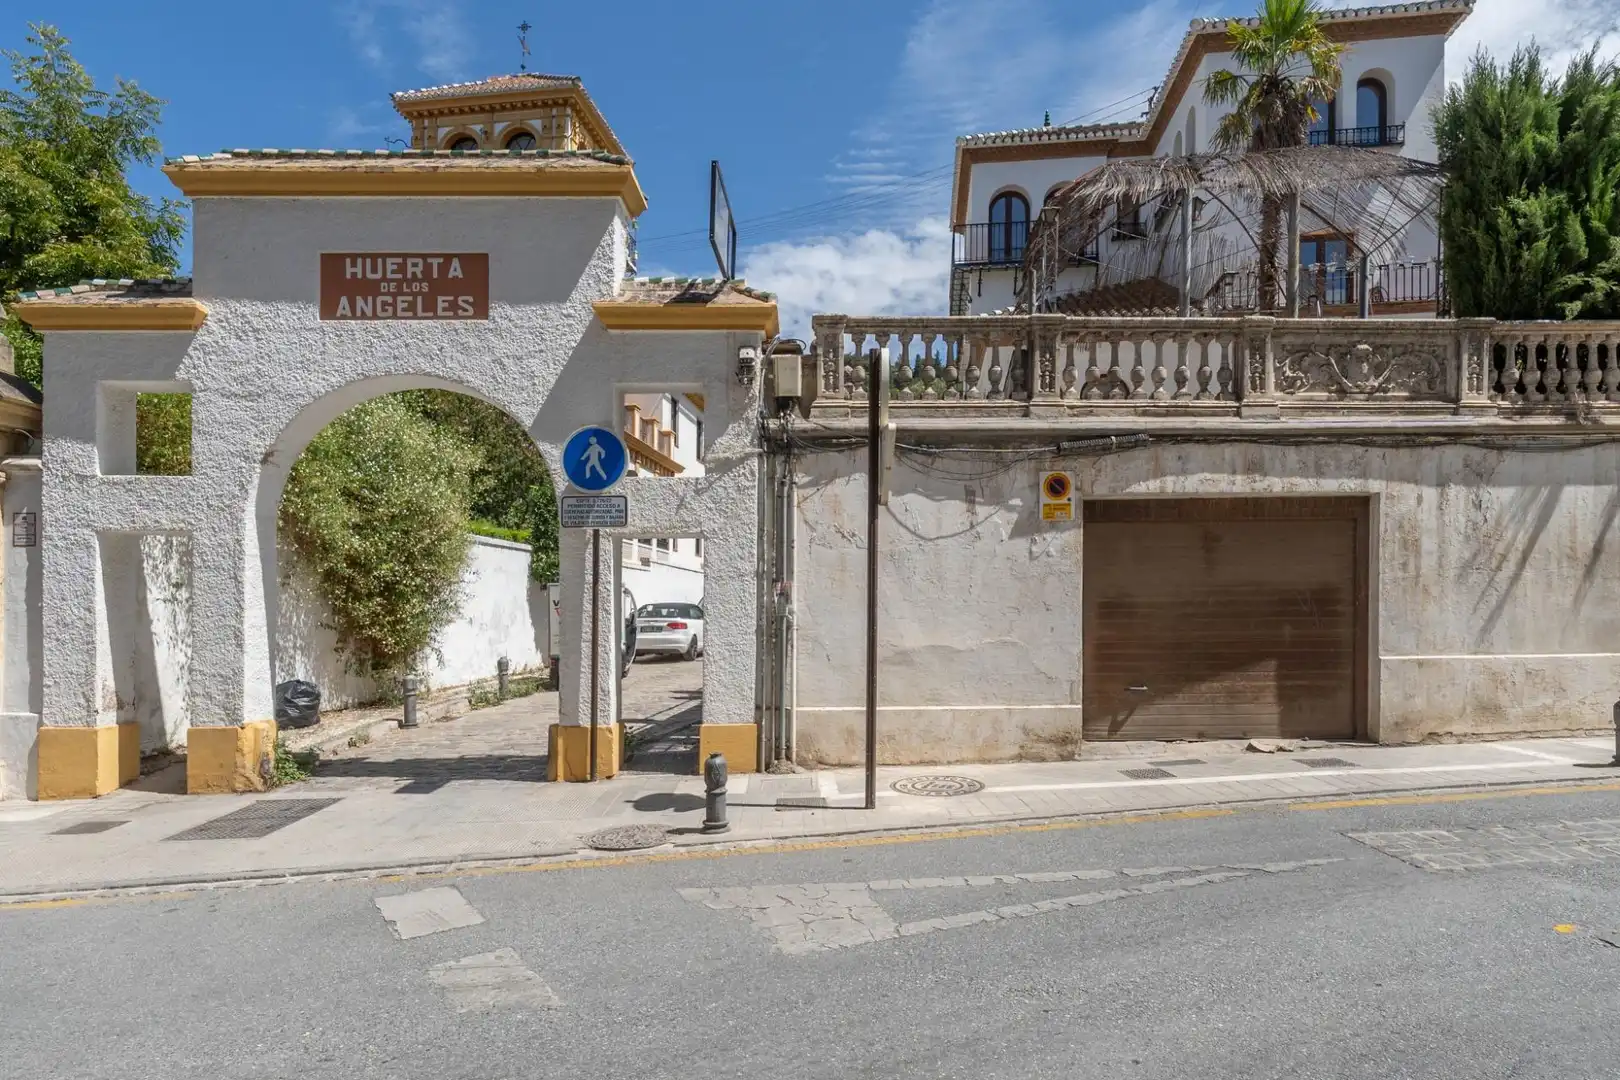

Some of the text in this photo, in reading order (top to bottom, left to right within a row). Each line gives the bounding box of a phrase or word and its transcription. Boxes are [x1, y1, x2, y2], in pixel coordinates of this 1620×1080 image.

[345, 257, 464, 279] HUERTA
[380, 282, 429, 292] DE LOS
[336, 296, 474, 317] ANGELES
